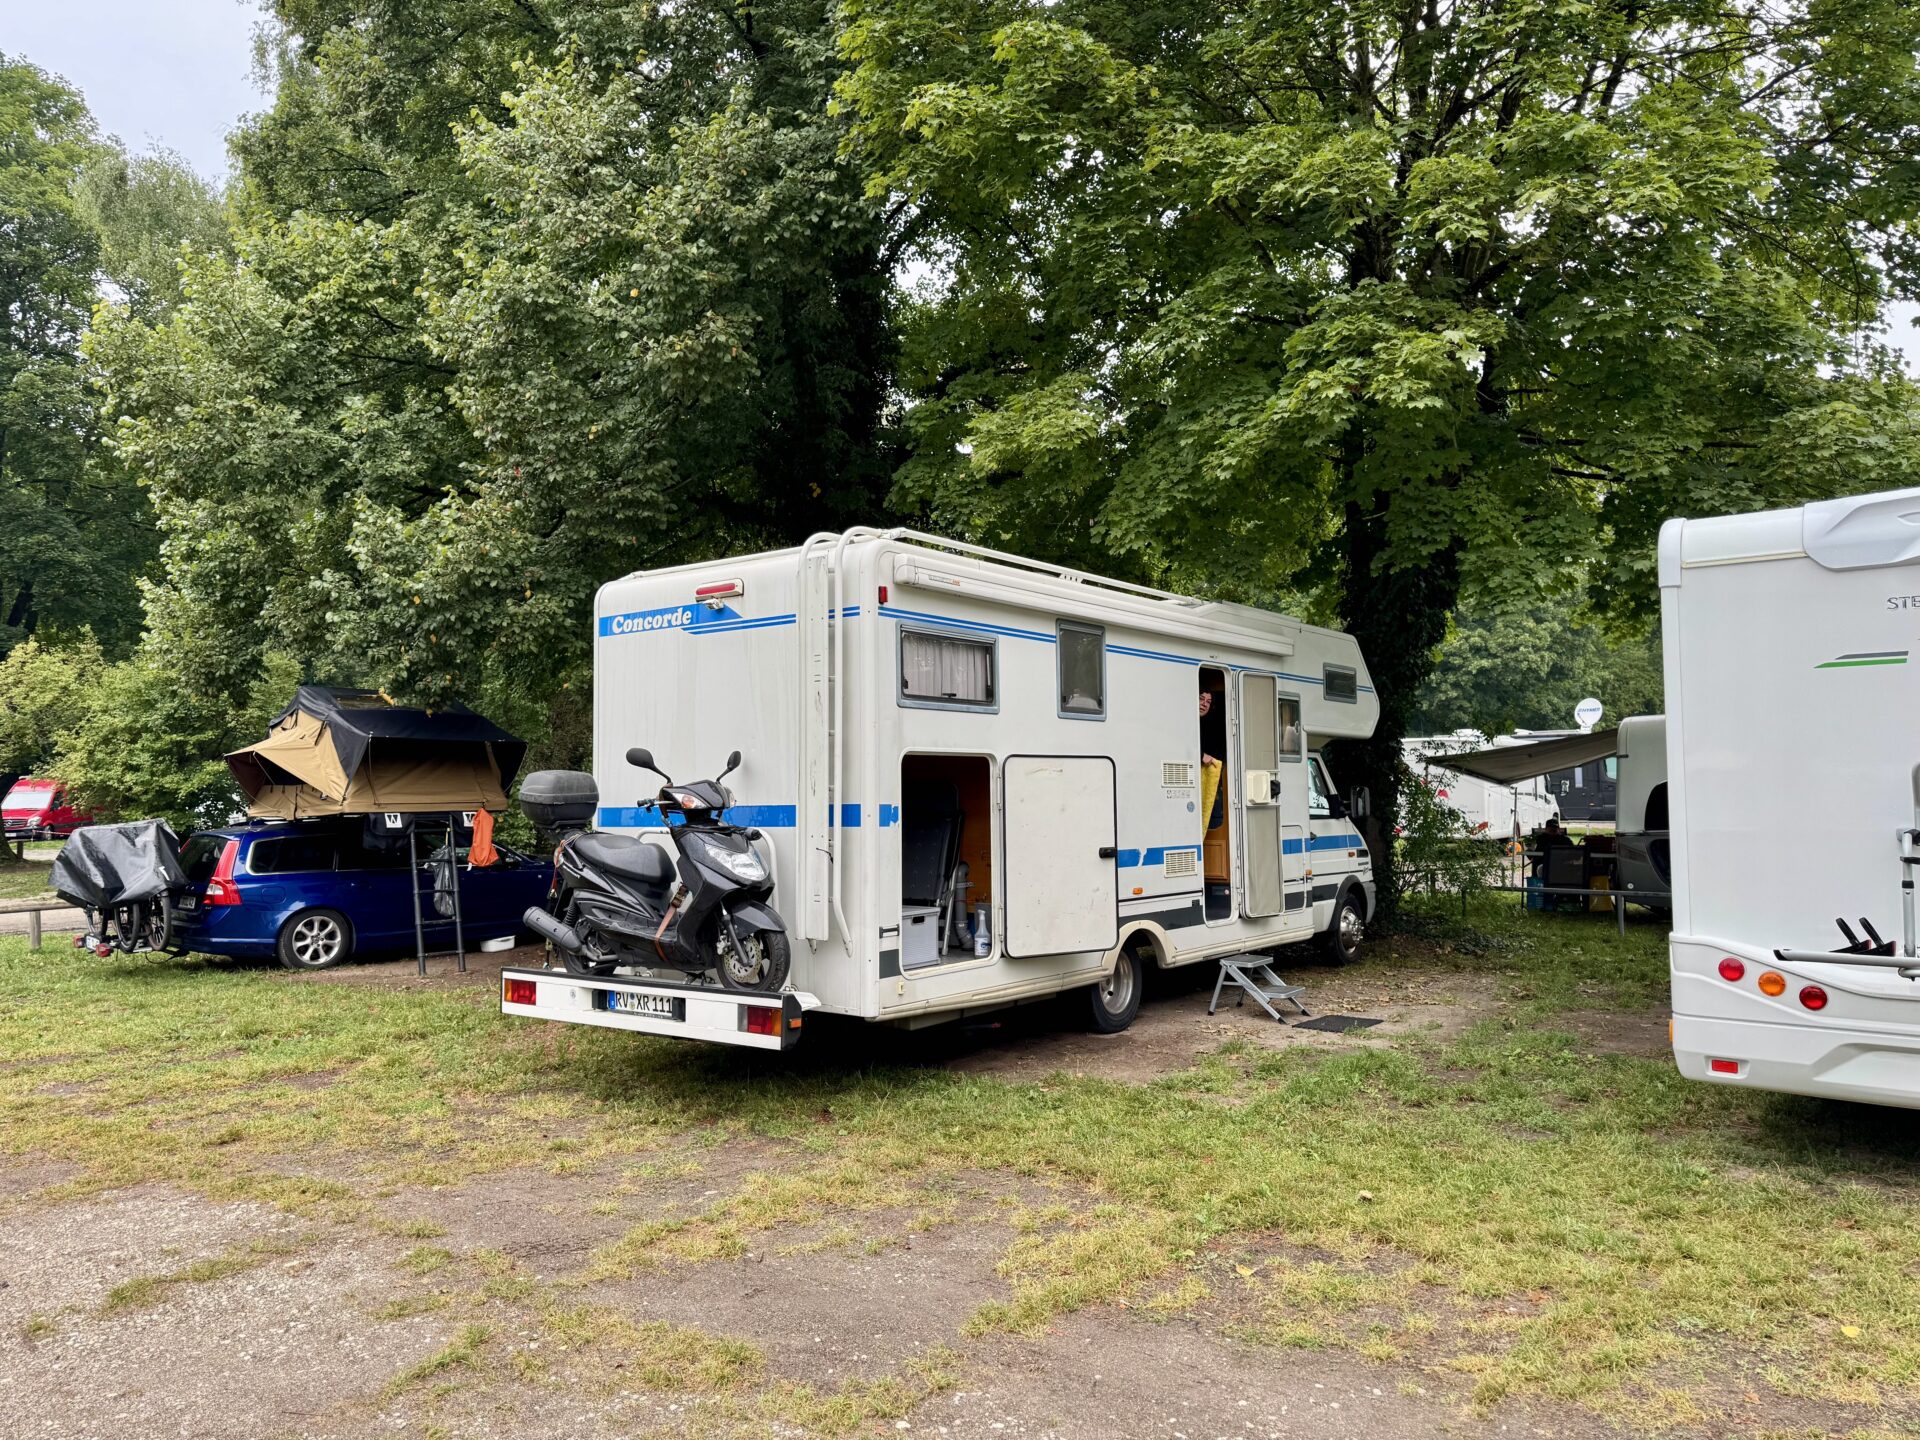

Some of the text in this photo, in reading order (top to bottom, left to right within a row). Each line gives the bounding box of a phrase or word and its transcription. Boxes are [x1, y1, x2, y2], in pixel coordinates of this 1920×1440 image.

[612, 607, 692, 634] Concorde
[616, 992, 672, 1013] RV XR 111
